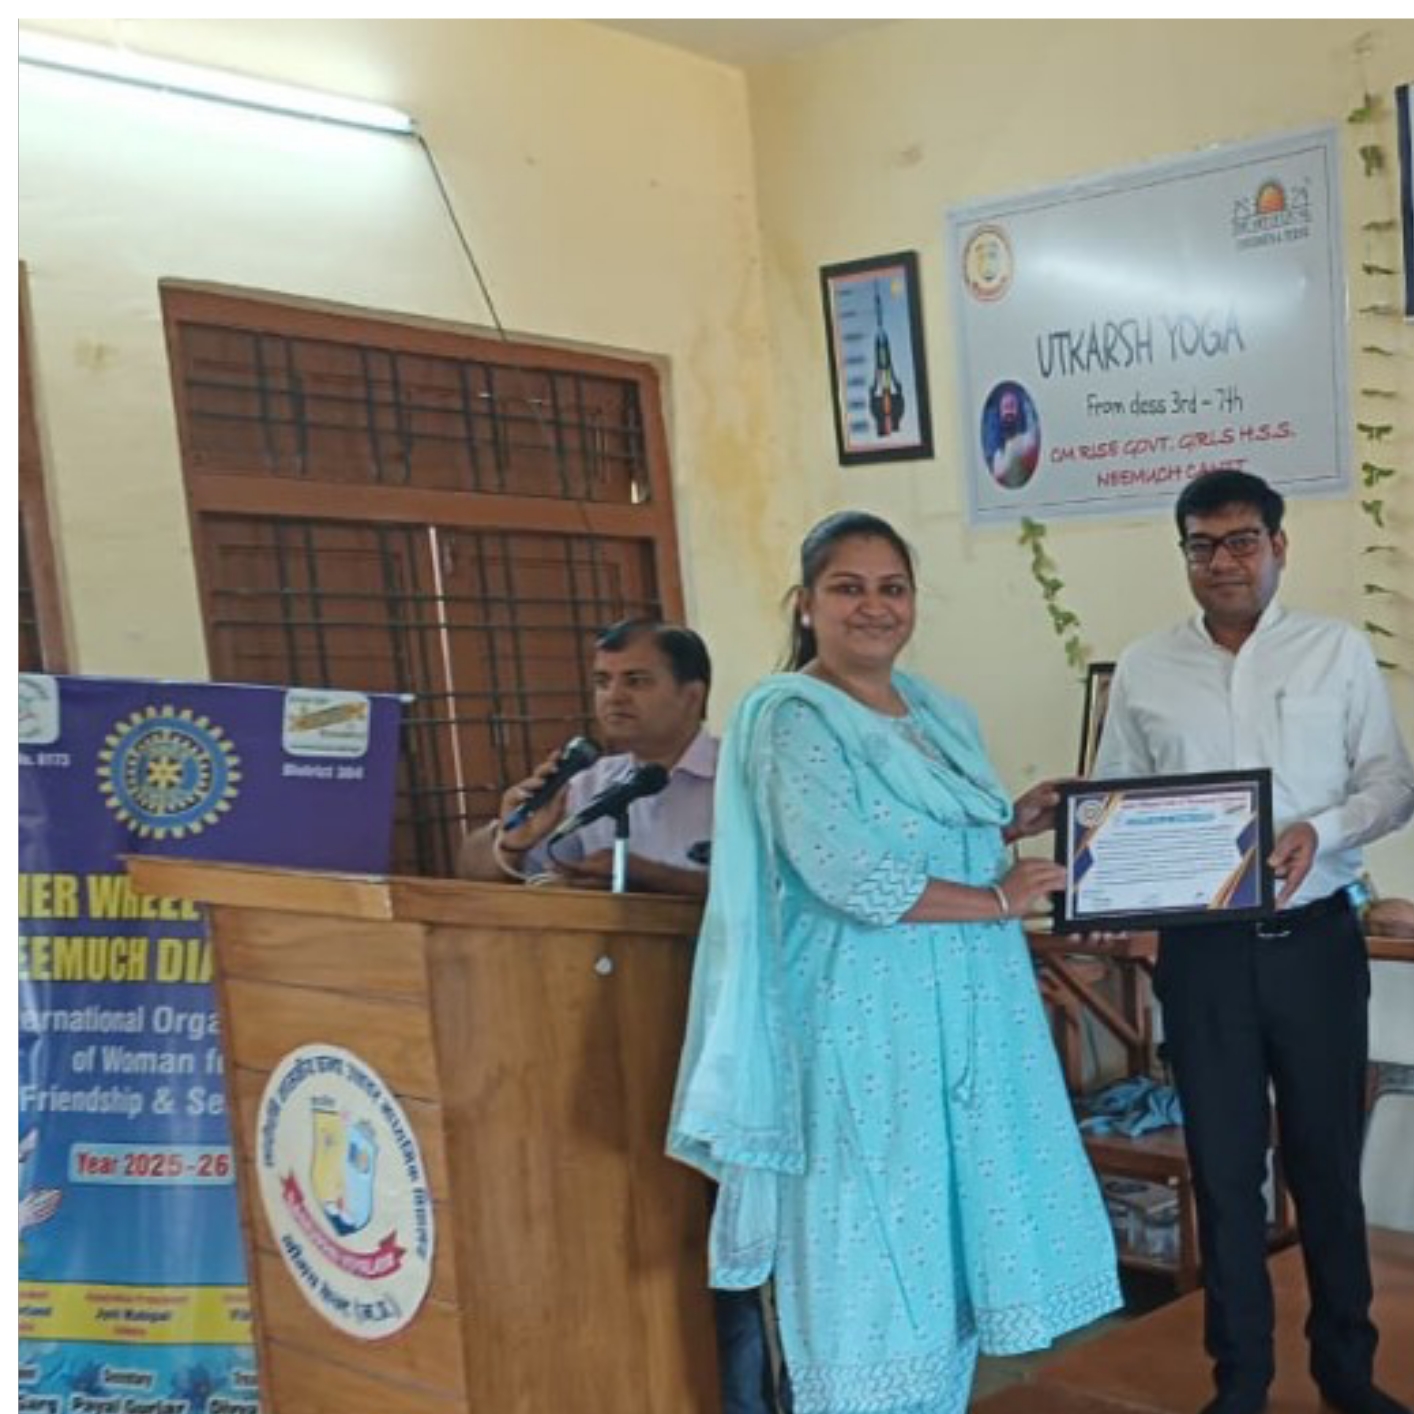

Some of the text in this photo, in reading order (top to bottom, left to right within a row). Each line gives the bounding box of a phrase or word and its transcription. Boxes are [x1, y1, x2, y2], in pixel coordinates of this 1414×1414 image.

[1037, 307, 1245, 378] UTKARSH YOGA
[1087, 393, 1125, 416] From
[1171, 387, 1197, 414] 3rd
[1216, 385, 1243, 414] 7th
[1079, 441, 1118, 461] RISE
[1178, 428, 1234, 451] GIRLS
[1097, 467, 1181, 487] NEEMUCH
[72, 1046, 95, 1072] of
[103, 1050, 194, 1074] Woman
[20, 1086, 175, 1118] Friendship &
[77, 1152, 117, 1173] Year
